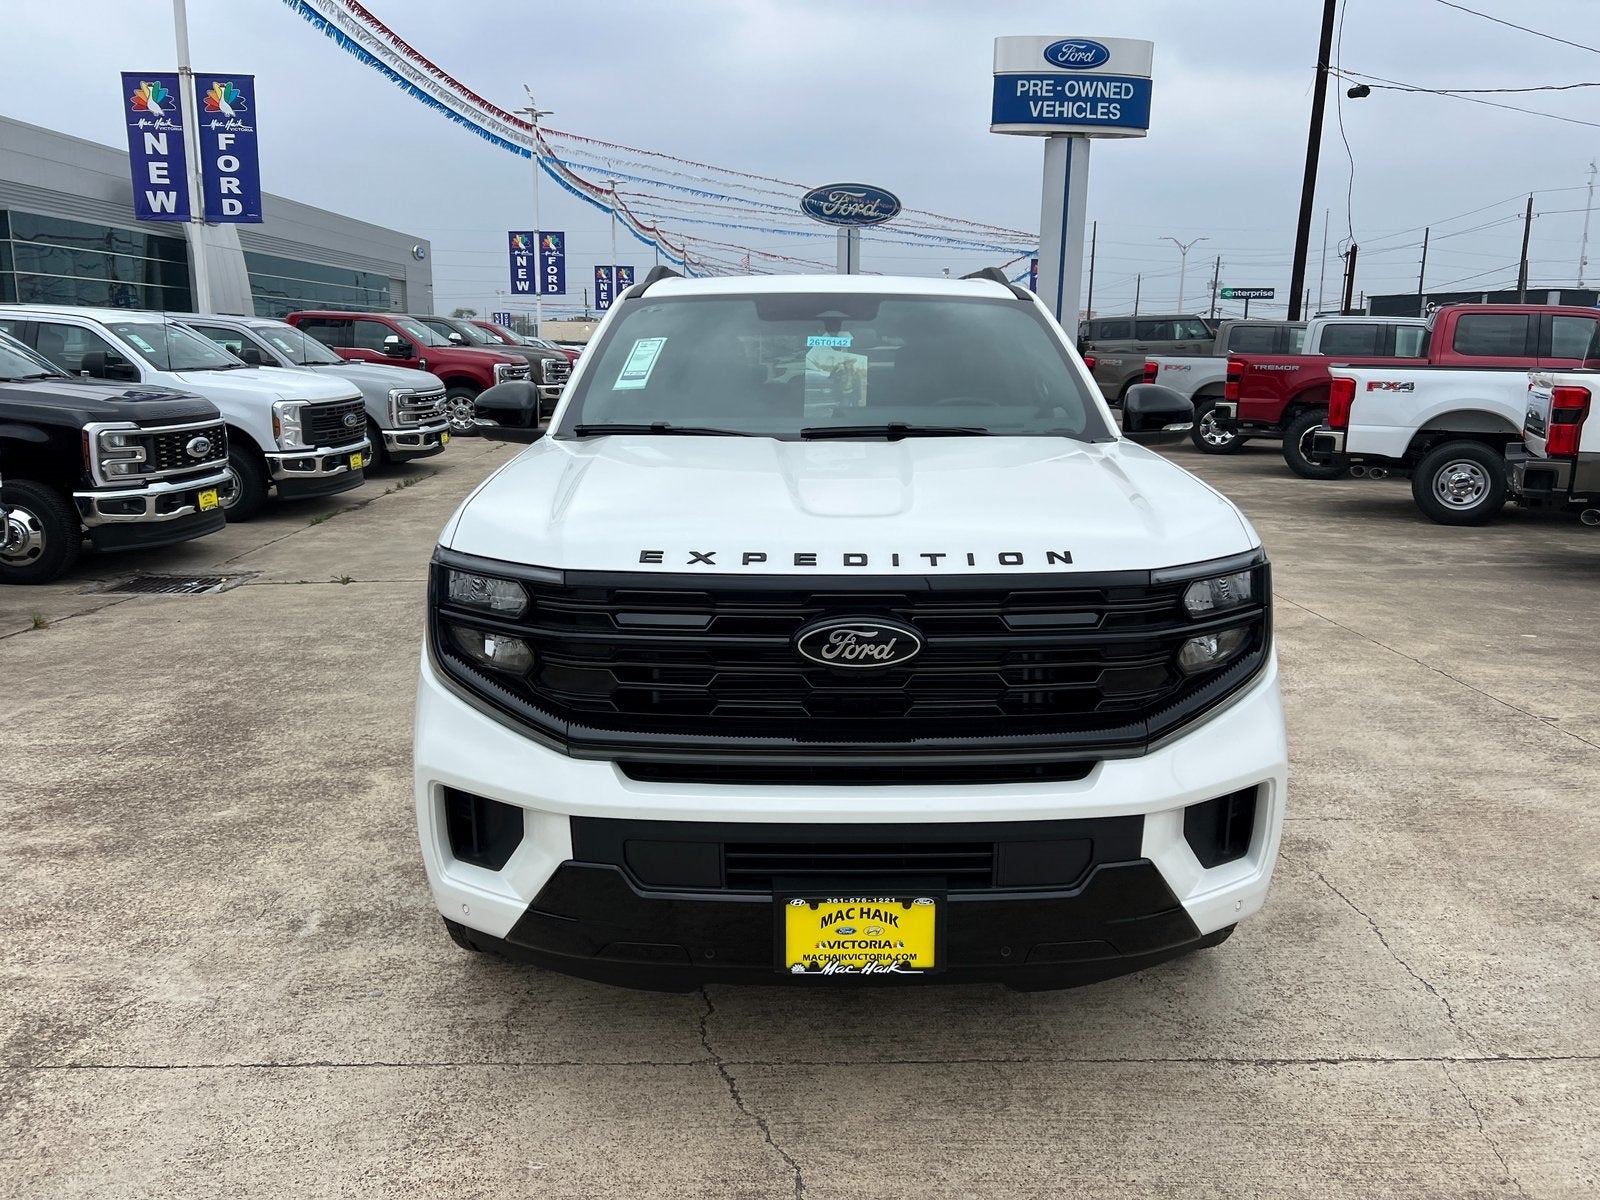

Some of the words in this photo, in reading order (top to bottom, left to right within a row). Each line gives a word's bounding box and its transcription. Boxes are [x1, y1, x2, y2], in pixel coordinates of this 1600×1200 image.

[1057, 43, 1095, 62] Ford
[1029, 101, 1121, 119] VEHICLES
[144, 132, 177, 213] NEW
[217, 133, 242, 215] FORD
[822, 191, 881, 217] Ford
[516, 256, 529, 291] NEW
[547, 257, 558, 292] FORD
[599, 283, 609, 308] NEW
[1223, 290, 1274, 298] enterprise
[1366, 381, 1415, 392] FX4
[639, 549, 1074, 567] EXPEDITION
[821, 629, 898, 661] Ford
[820, 907, 855, 929] MAC
[860, 907, 899, 928] HAIK
[828, 940, 893, 949] VICTORIA
[802, 953, 917, 962] MACHAIKVICTORIA.COM
[819, 960, 860, 976] Mac
[860, 960, 901, 976] Haik
